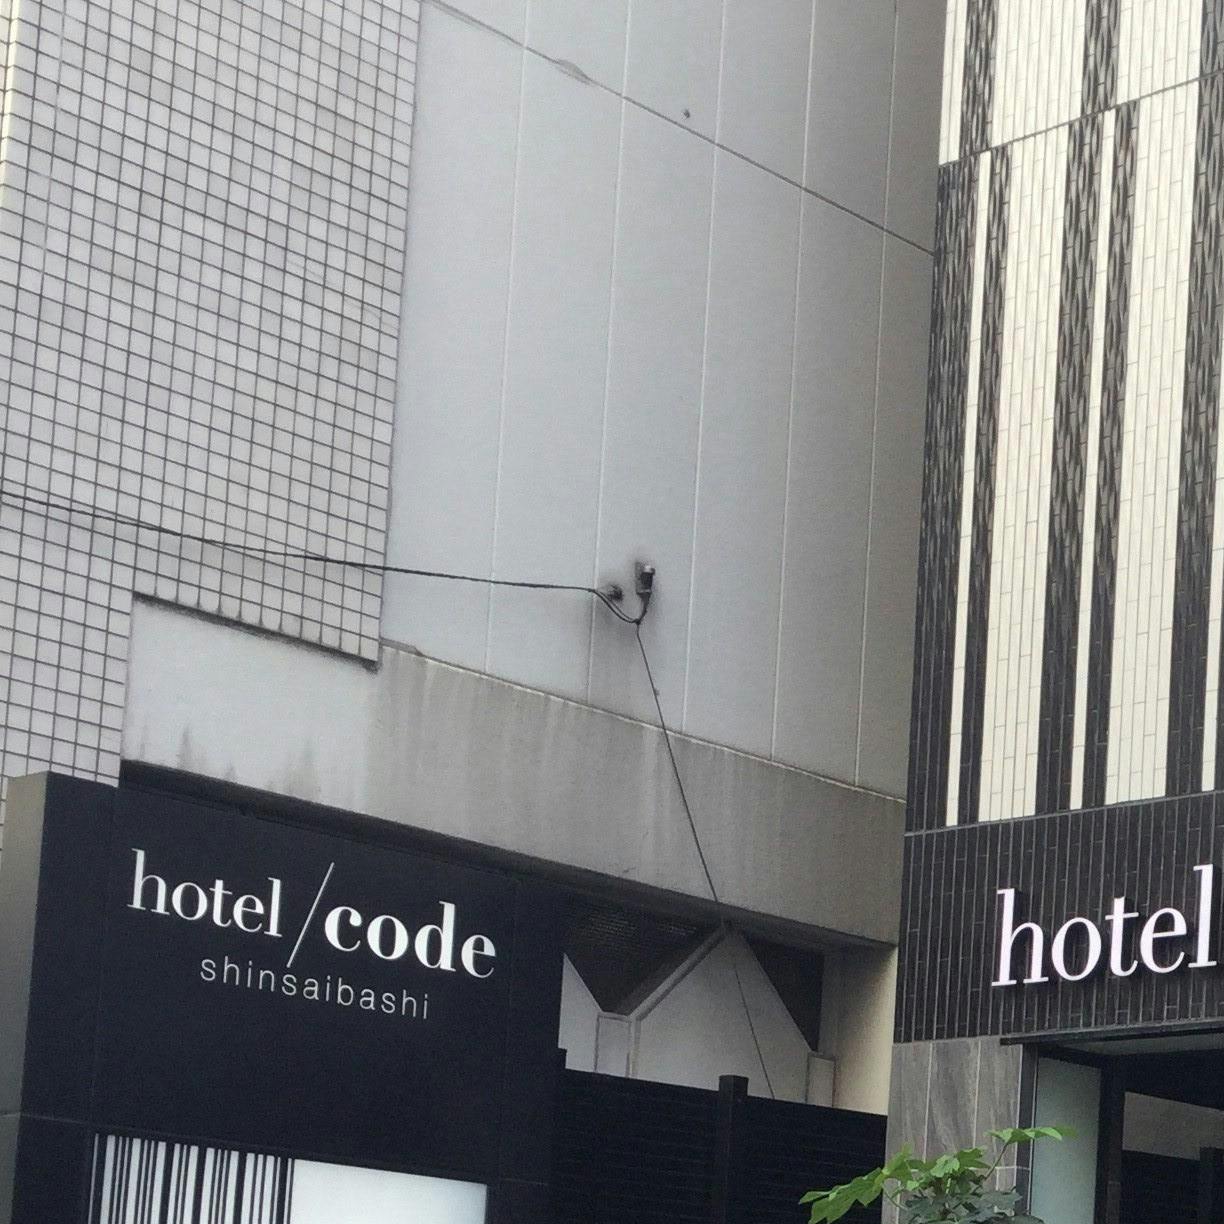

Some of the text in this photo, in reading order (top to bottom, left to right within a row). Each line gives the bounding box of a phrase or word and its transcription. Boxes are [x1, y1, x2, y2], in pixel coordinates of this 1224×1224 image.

[126, 847, 283, 938] hotel
[991, 864, 1218, 987] hotel
[200, 955, 429, 1020] shinsaibashi
